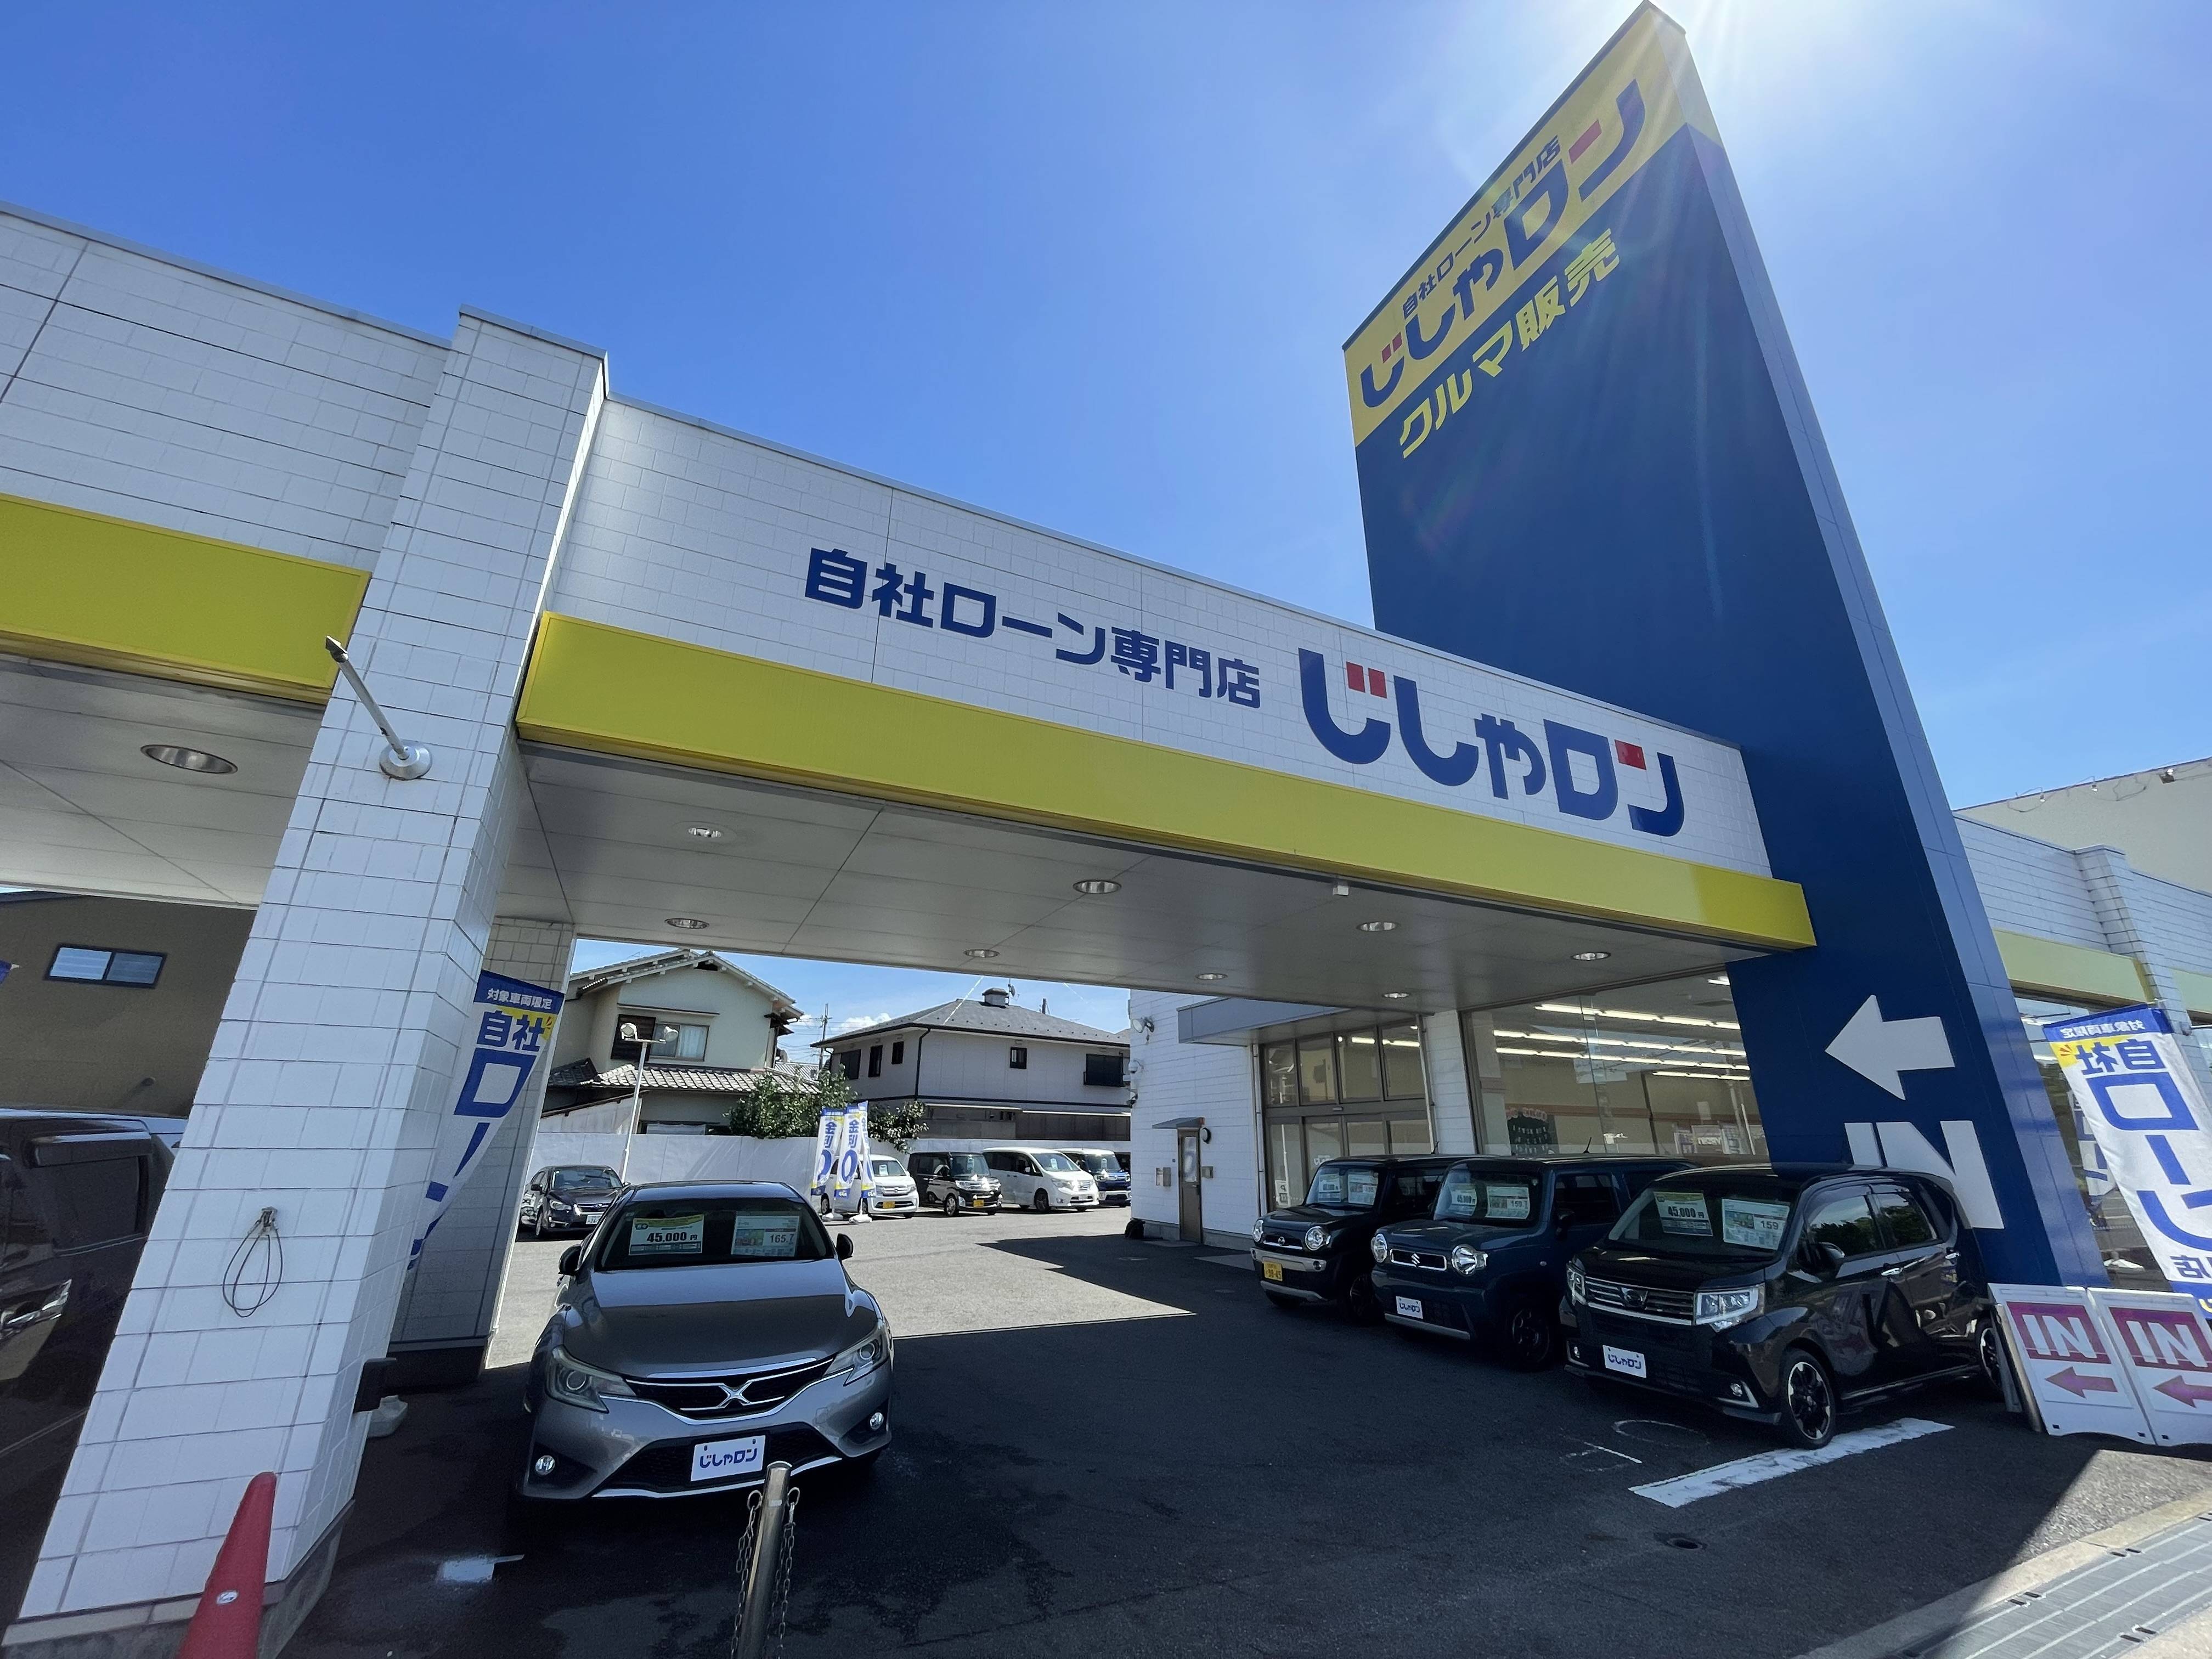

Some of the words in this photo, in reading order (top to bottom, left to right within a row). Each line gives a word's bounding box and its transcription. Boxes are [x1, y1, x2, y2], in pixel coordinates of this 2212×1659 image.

[1360, 79, 1645, 408] じしゃロン
[1402, 135, 1560, 320] 自社ローン専門店
[1400, 228, 1620, 459] クルマ販売
[805, 549, 1261, 709] 自社ローン専門店
[1299, 647, 1685, 837] じしゃロン
[487, 988, 552, 1009] 対象車両限定
[2022, 1314, 2097, 1359] IN
[2125, 1321, 2208, 1368] IN
[699, 1448, 758, 1468] じしゃロン
